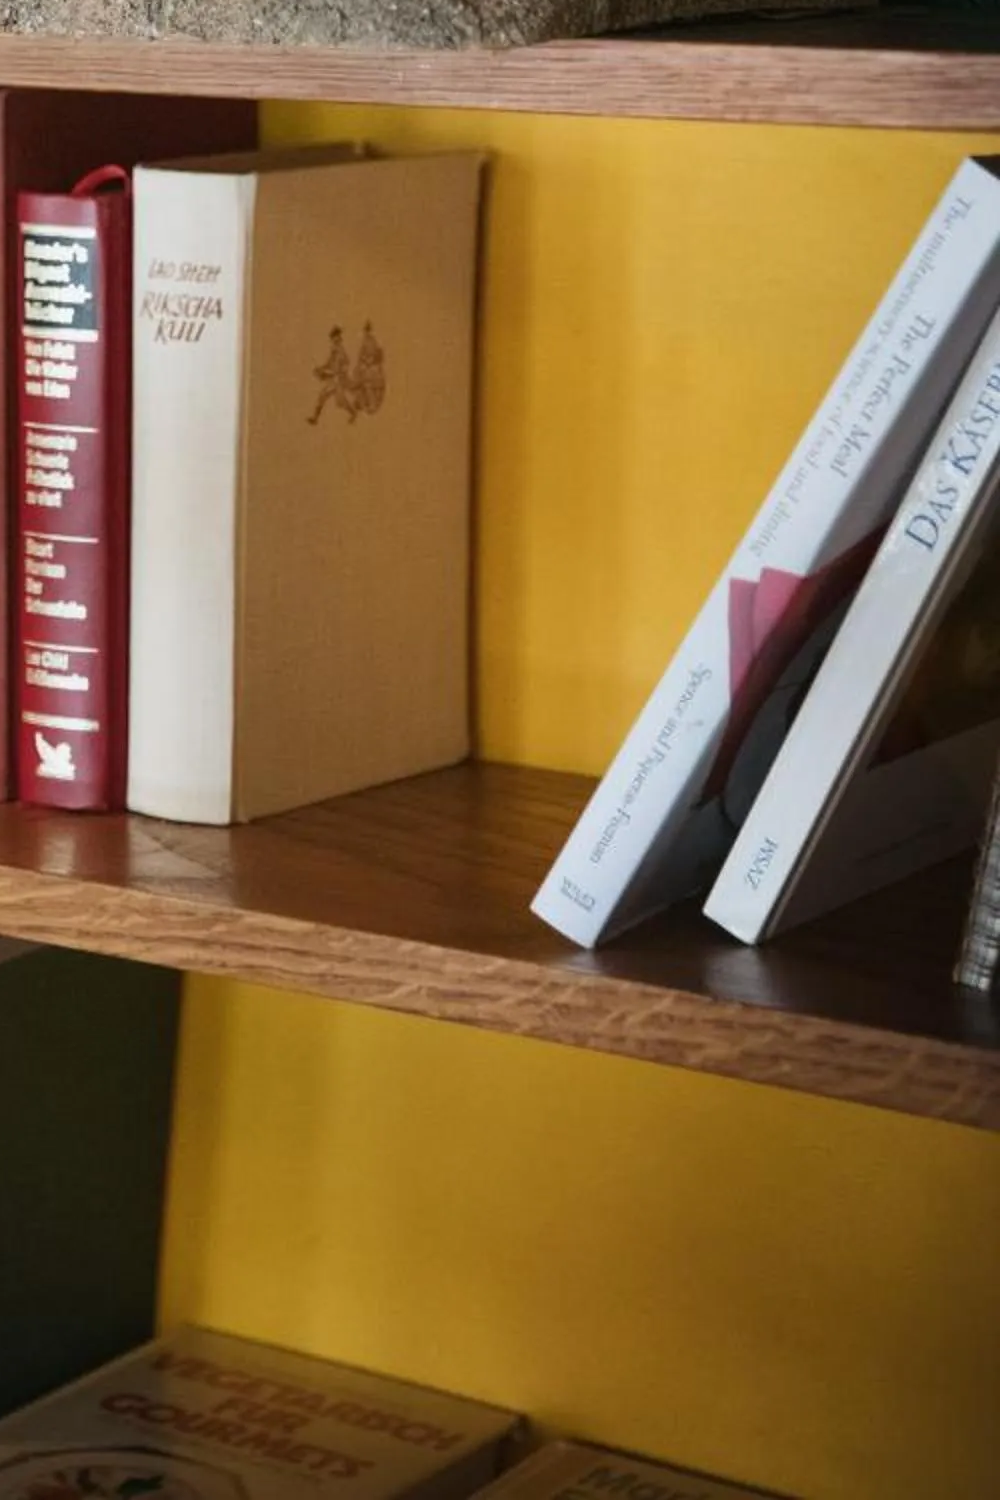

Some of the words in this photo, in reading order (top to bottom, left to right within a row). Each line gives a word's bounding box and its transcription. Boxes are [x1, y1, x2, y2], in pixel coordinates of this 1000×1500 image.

[900, 314, 934, 355] The
[860, 356, 910, 424] Perfect
[830, 426, 870, 477] Meal
[903, 479, 960, 553] DAS
[100, 1392, 377, 1479] GOURMETS
